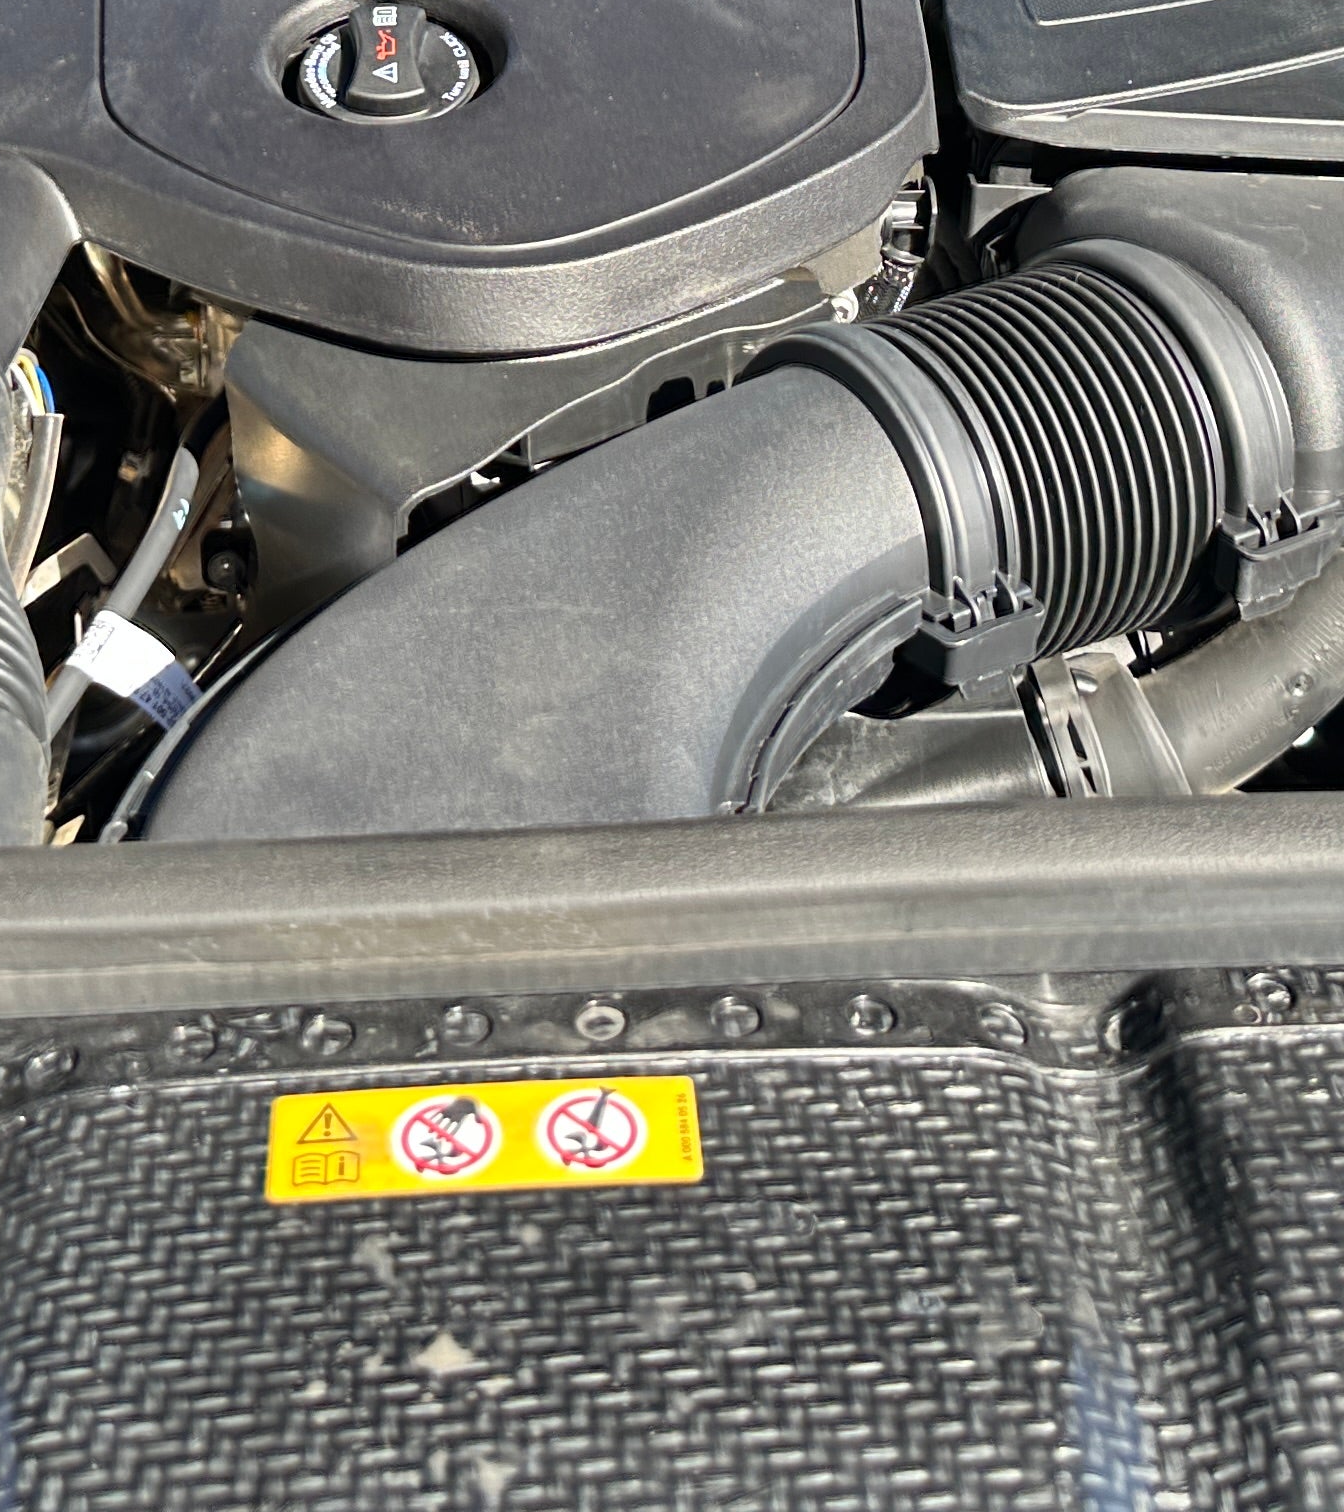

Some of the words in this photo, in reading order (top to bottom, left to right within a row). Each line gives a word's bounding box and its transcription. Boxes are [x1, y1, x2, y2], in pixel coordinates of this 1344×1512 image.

[438, 31, 467, 58] CLICK
[440, 81, 466, 101] Turn
[681, 1137, 692, 1153] 000
